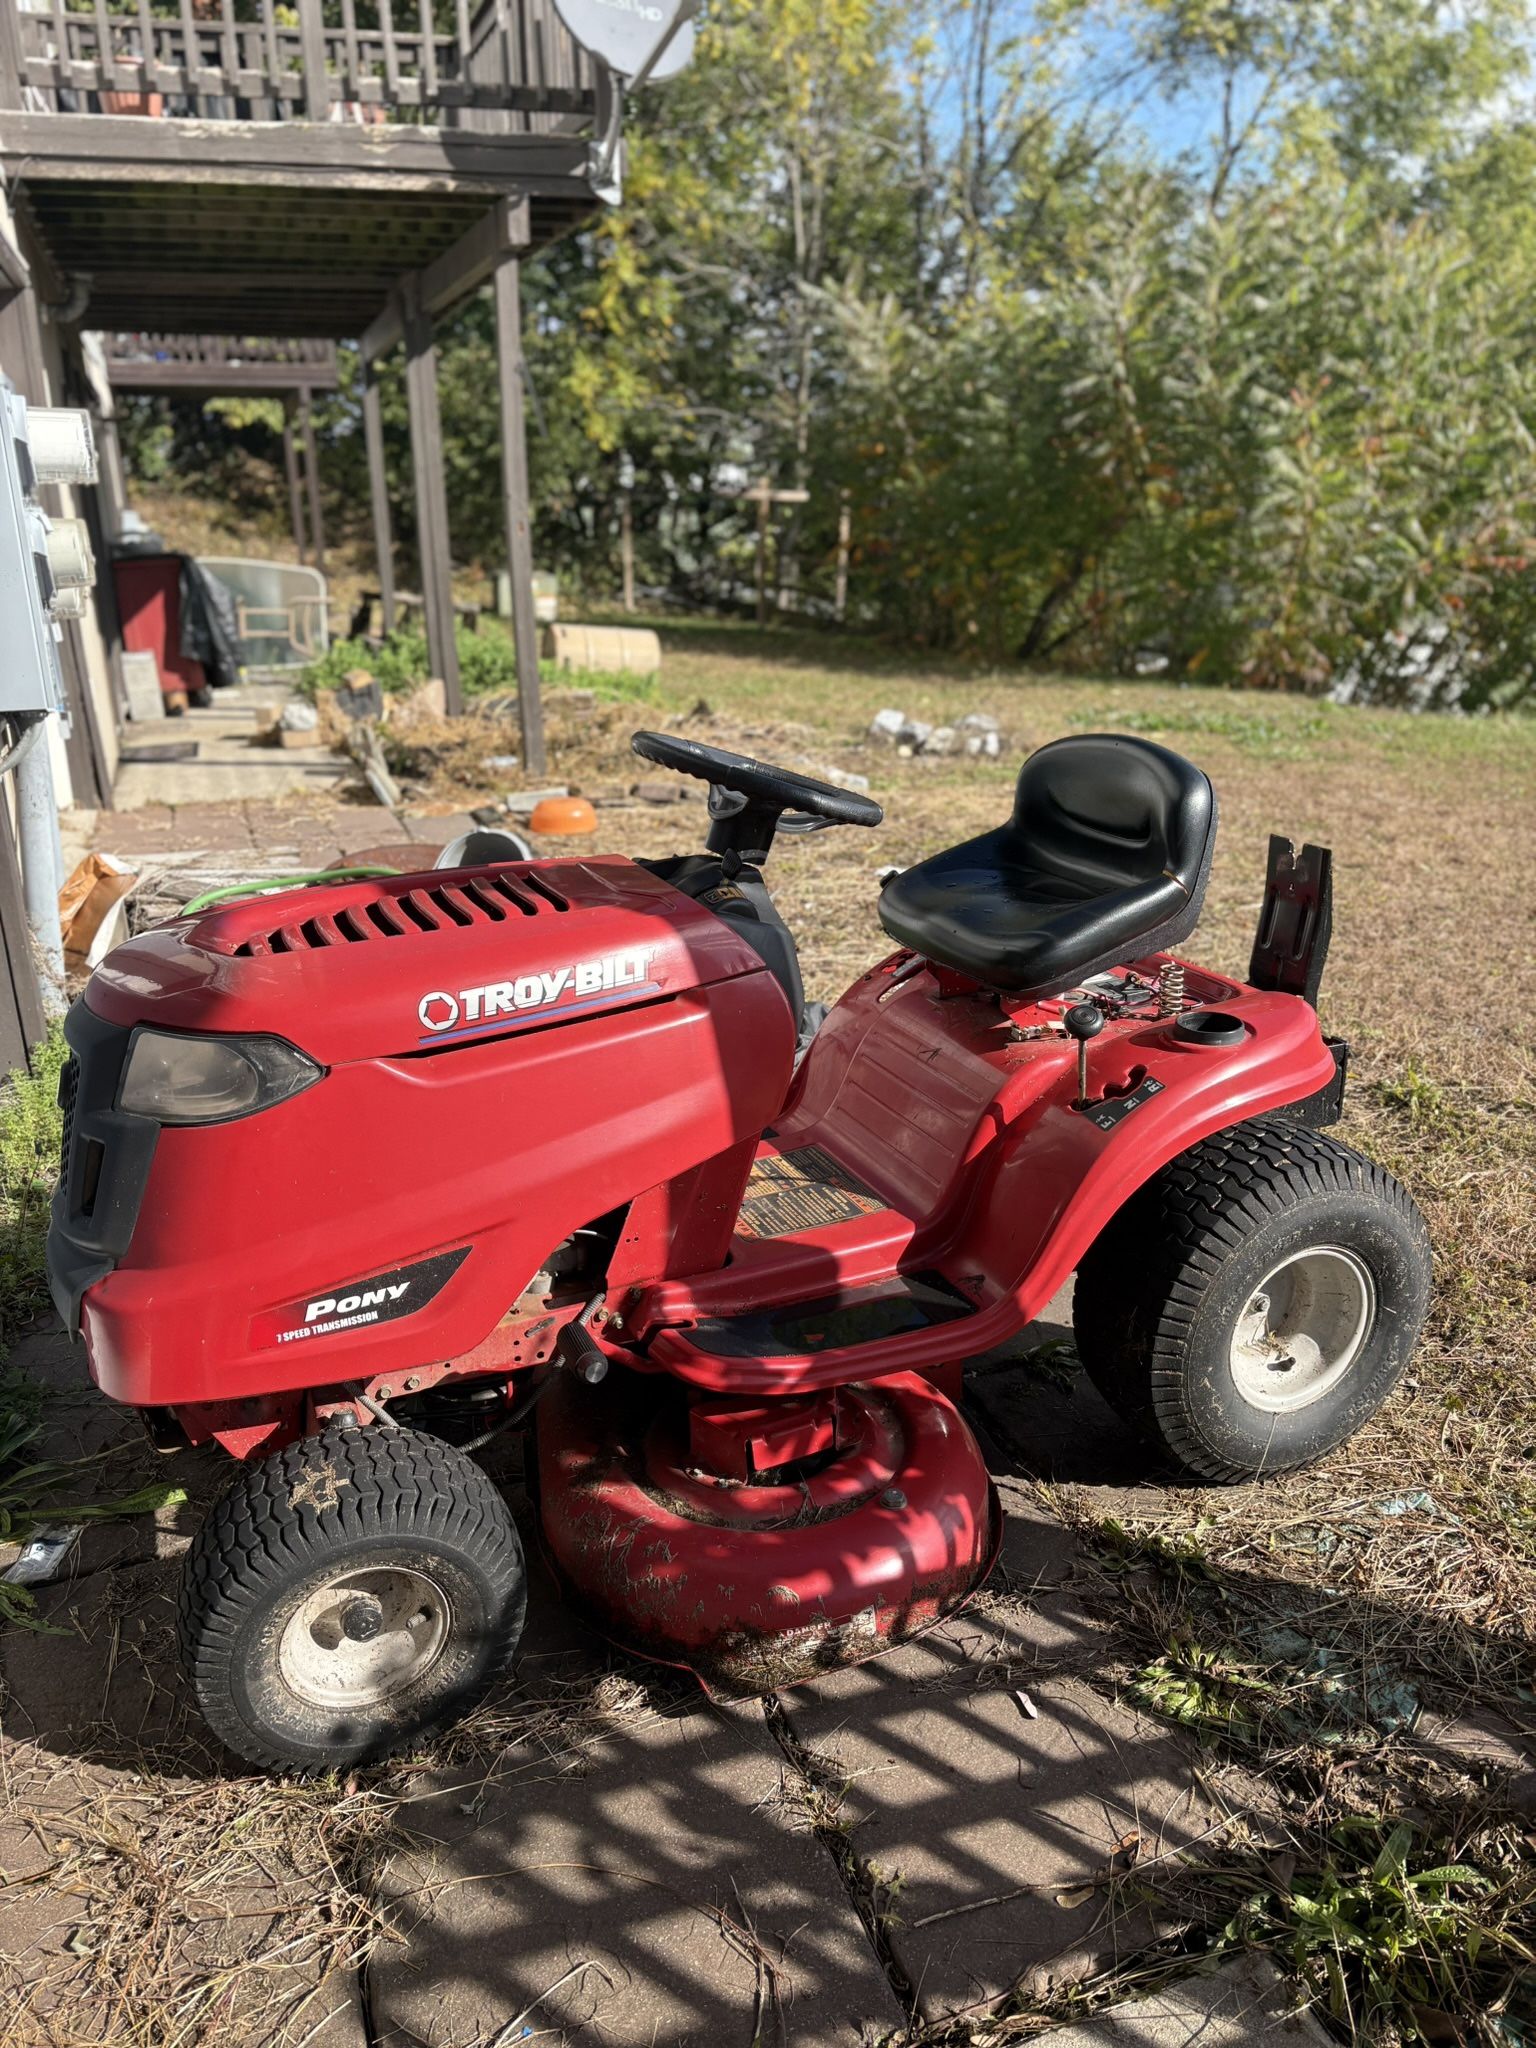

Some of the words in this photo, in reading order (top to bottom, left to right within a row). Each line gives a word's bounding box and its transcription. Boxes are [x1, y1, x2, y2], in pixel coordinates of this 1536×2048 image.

[459, 947, 656, 1021] TROY-BILT
[283, 1327, 311, 1343] SPEED
[311, 1310, 379, 1336] TRANSMISSION
